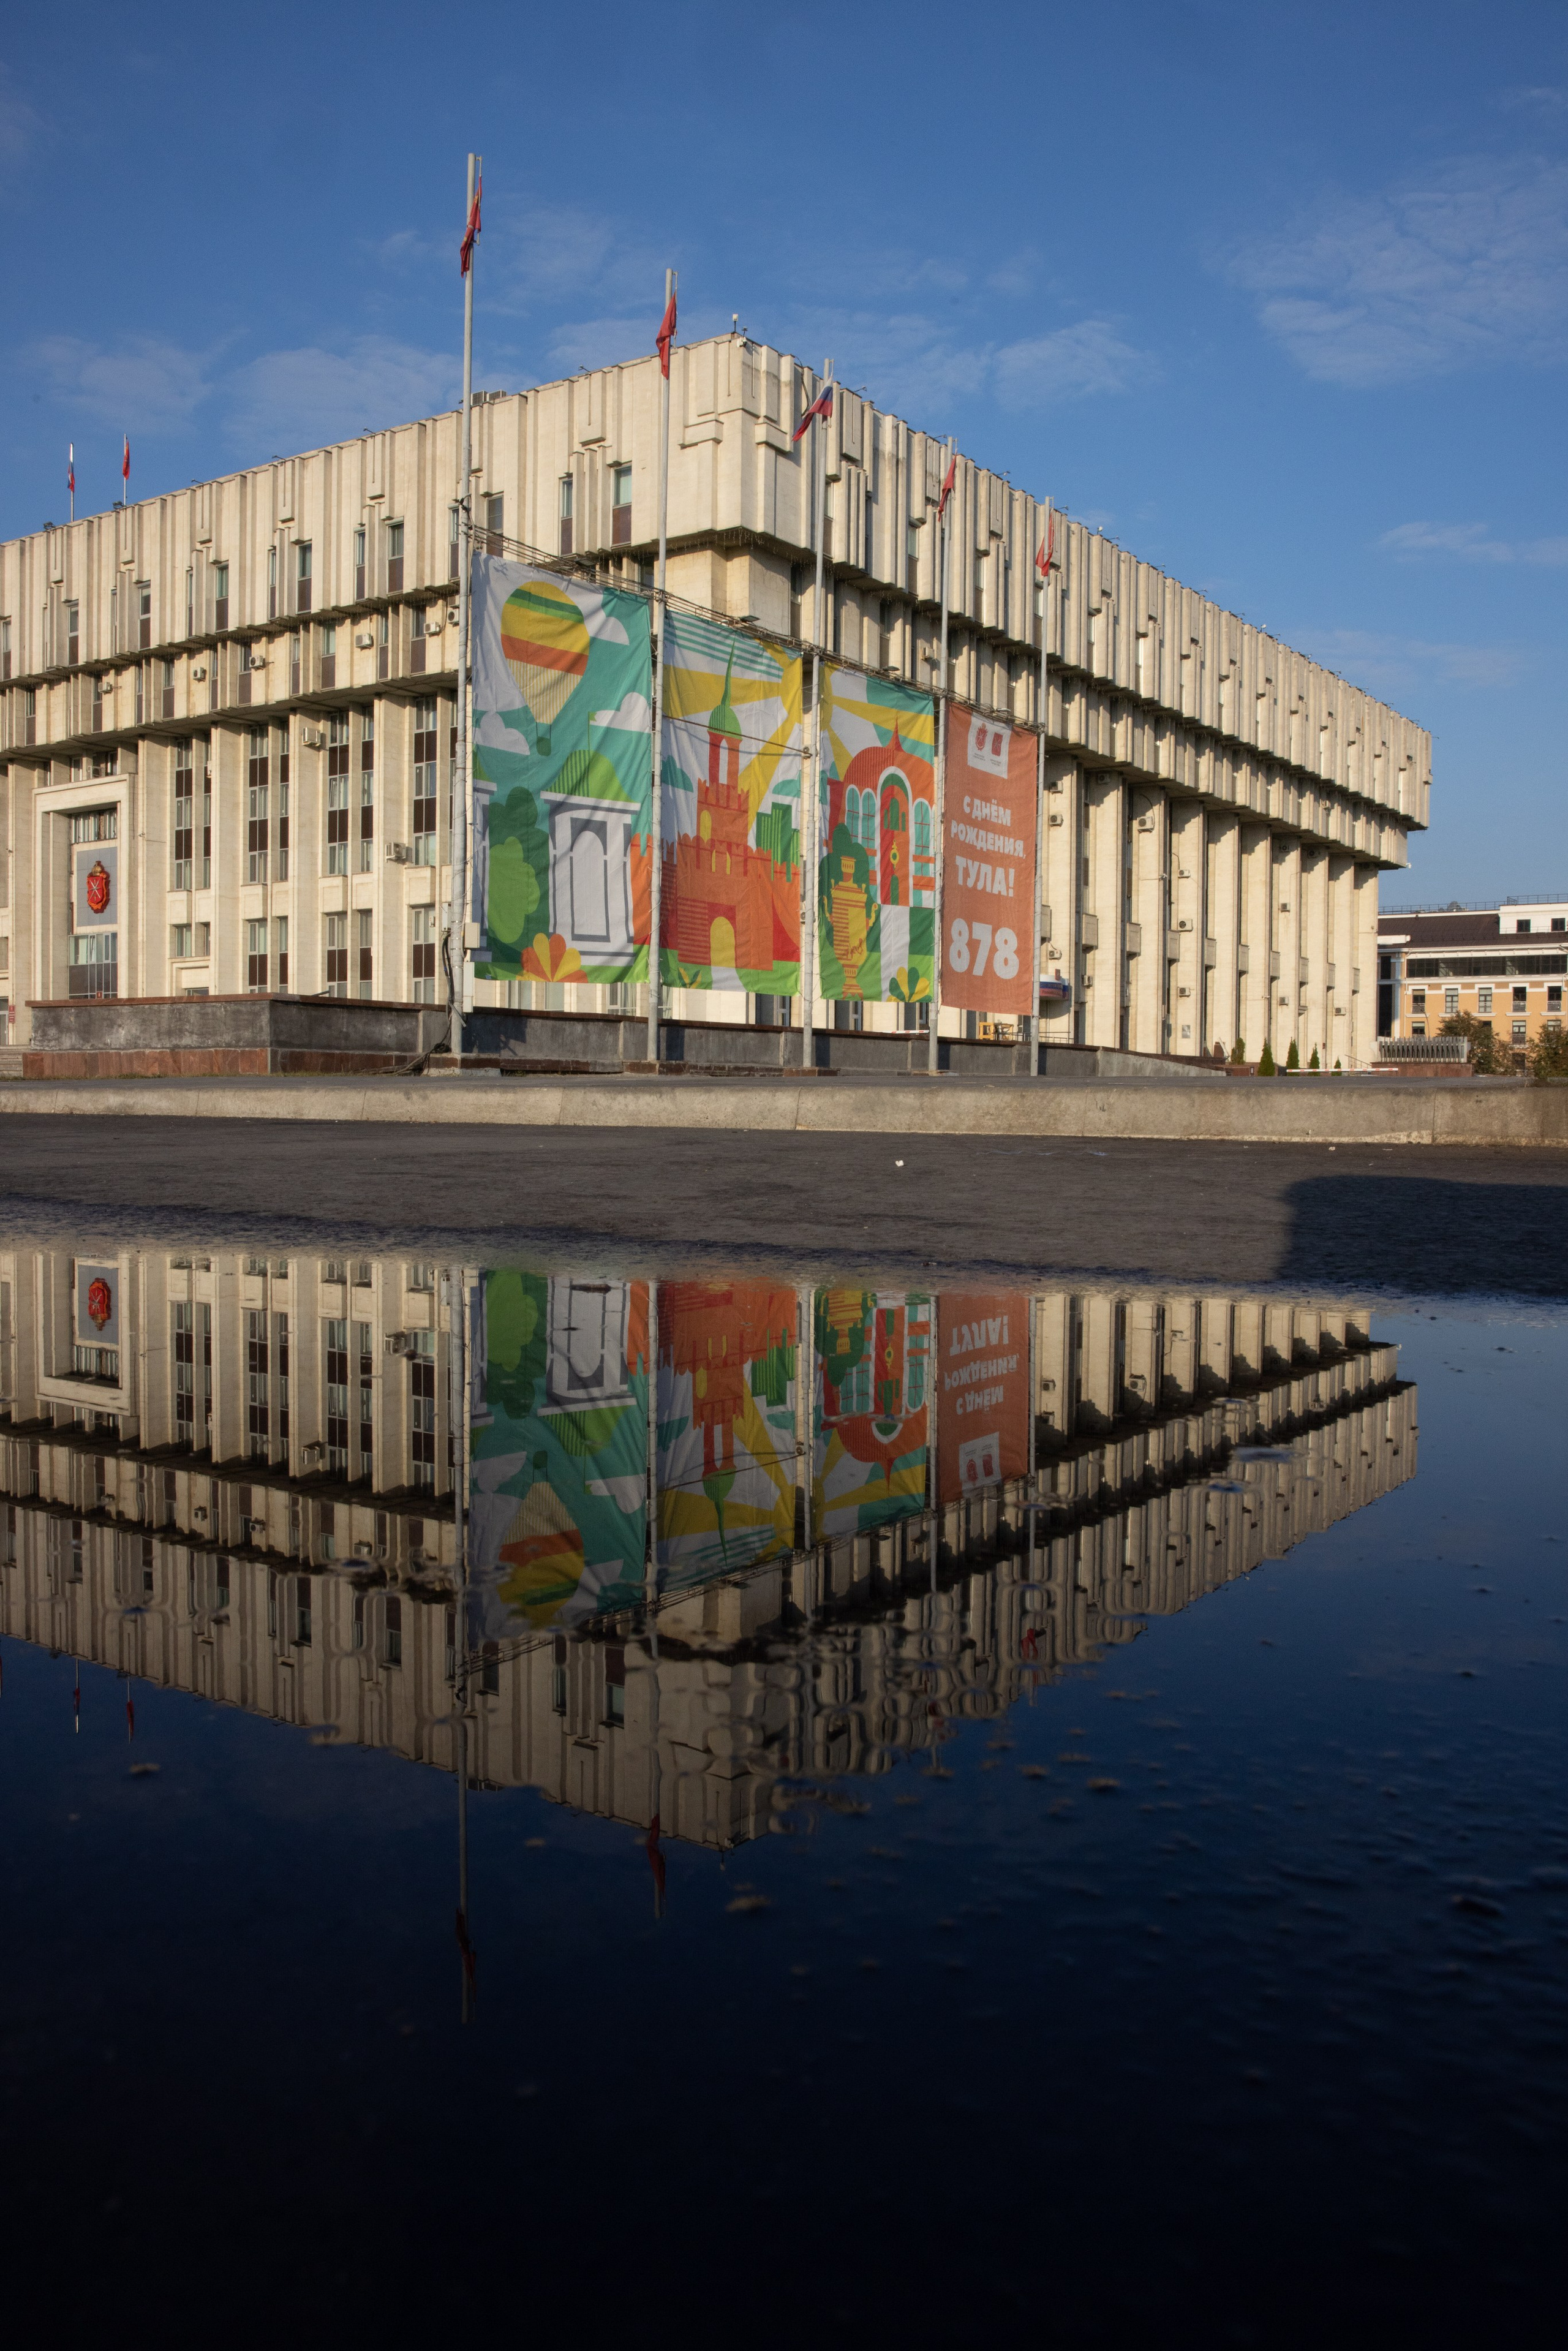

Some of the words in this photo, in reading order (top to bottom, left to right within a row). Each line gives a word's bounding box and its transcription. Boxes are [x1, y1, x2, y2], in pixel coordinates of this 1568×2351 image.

[963, 796, 971, 813] С
[972, 799, 1011, 826] ДНЁМ
[951, 820, 1026, 859] РОЖДЕНИЯ,
[956, 855, 1015, 897] ТУЛА!
[949, 918, 1019, 979] 878
